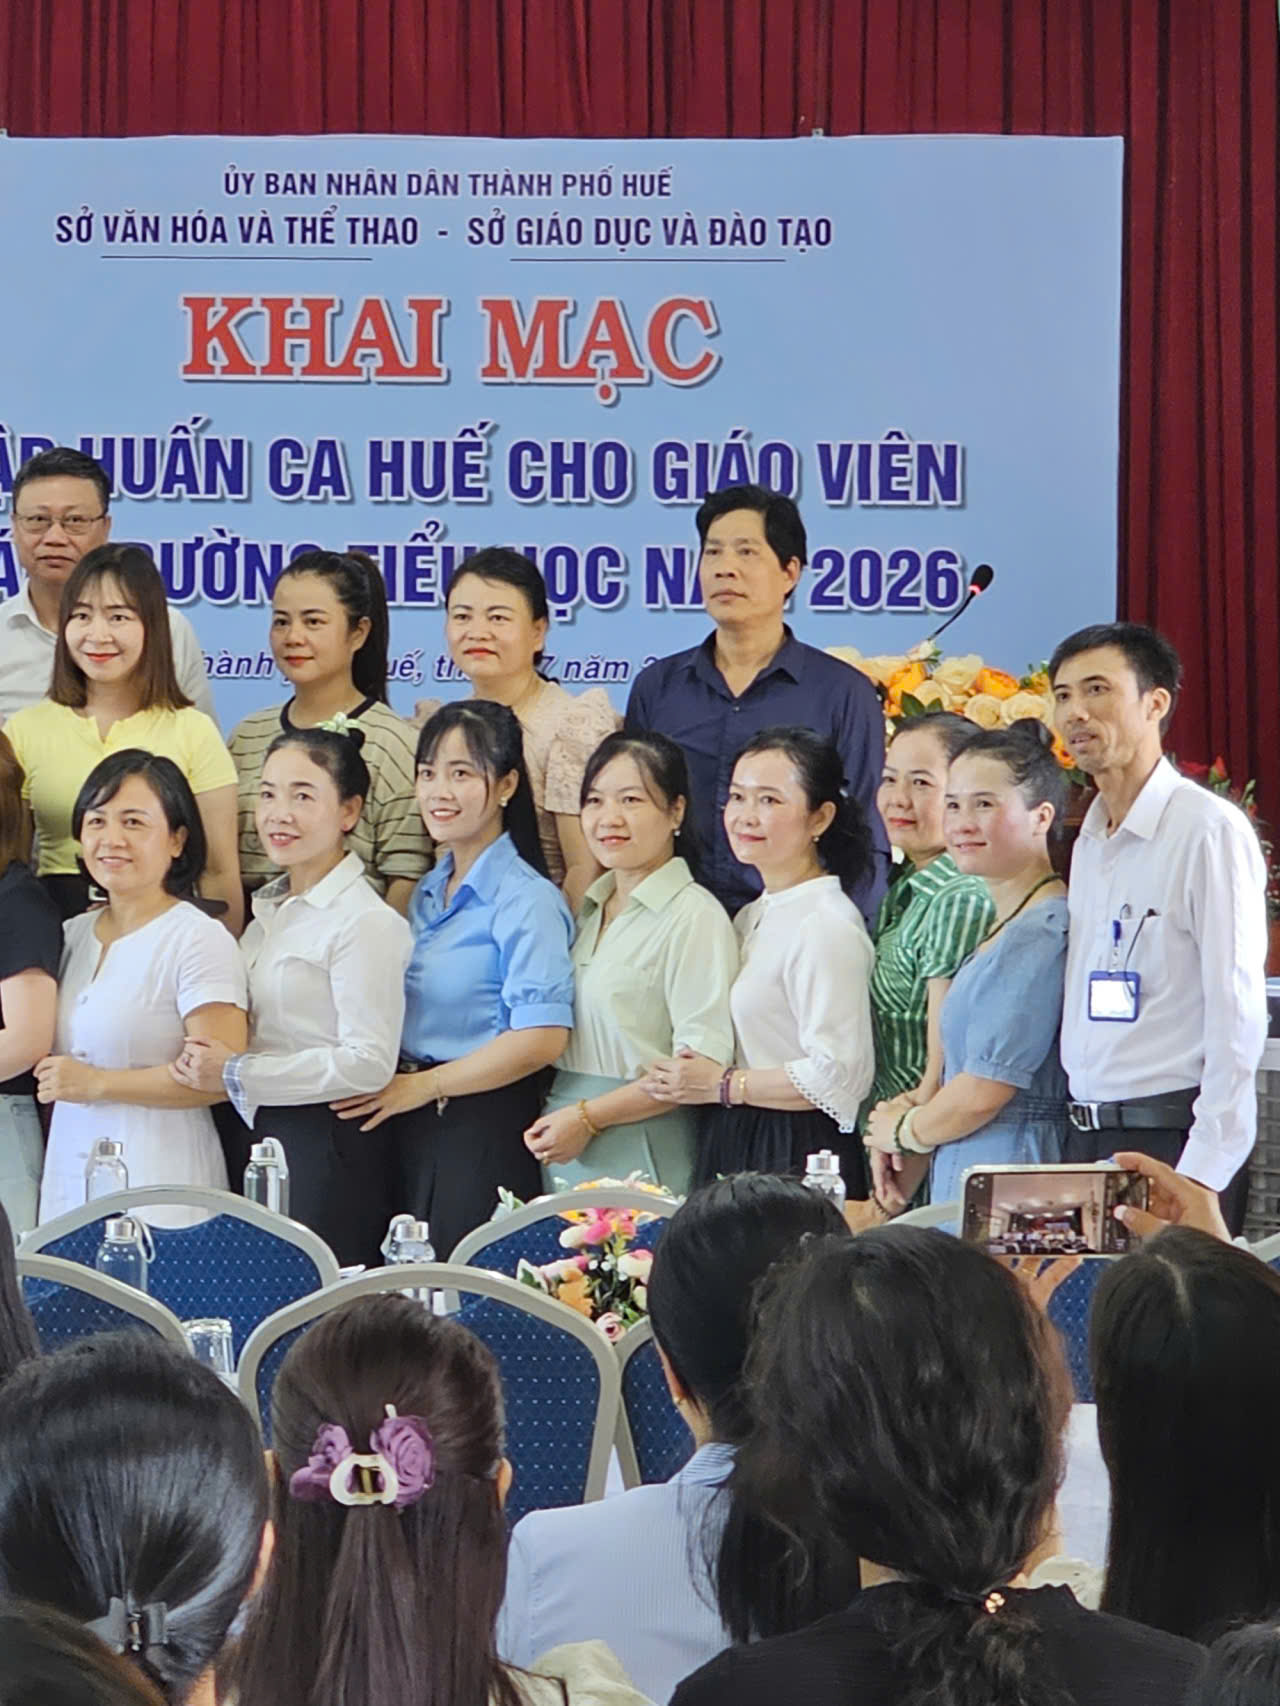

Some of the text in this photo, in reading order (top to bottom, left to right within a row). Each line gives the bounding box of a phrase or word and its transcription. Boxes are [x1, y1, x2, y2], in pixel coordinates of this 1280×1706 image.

[224, 163, 673, 197] ỦY BAN NHÂN DÂN THÀNH PHỐ HUẾ
[55, 205, 94, 244] SỞ
[103, 209, 160, 243] VĂN
[171, 209, 228, 244] HÓA
[237, 209, 274, 244] VÀ
[284, 204, 338, 245] THỂ
[345, 217, 418, 245] THAO
[467, 207, 506, 246] SỞ
[516, 211, 583, 246] GIÁO
[594, 217, 651, 252] DỤC
[662, 211, 699, 246] VÀ
[708, 211, 767, 247] ĐÀO
[777, 218, 832, 252] TẠO
[181, 295, 717, 403] KHAI MẠC
[269, 438, 346, 498] CA
[370, 423, 490, 500] HUẾ
[509, 440, 628, 502] CHO
[653, 429, 795, 500] GIÁO
[818, 432, 958, 503] VIÊN
[505, 545, 623, 618] ỌC
[809, 548, 960, 610] 2026
[201, 650, 274, 675] hành
[564, 655, 629, 679] năm
